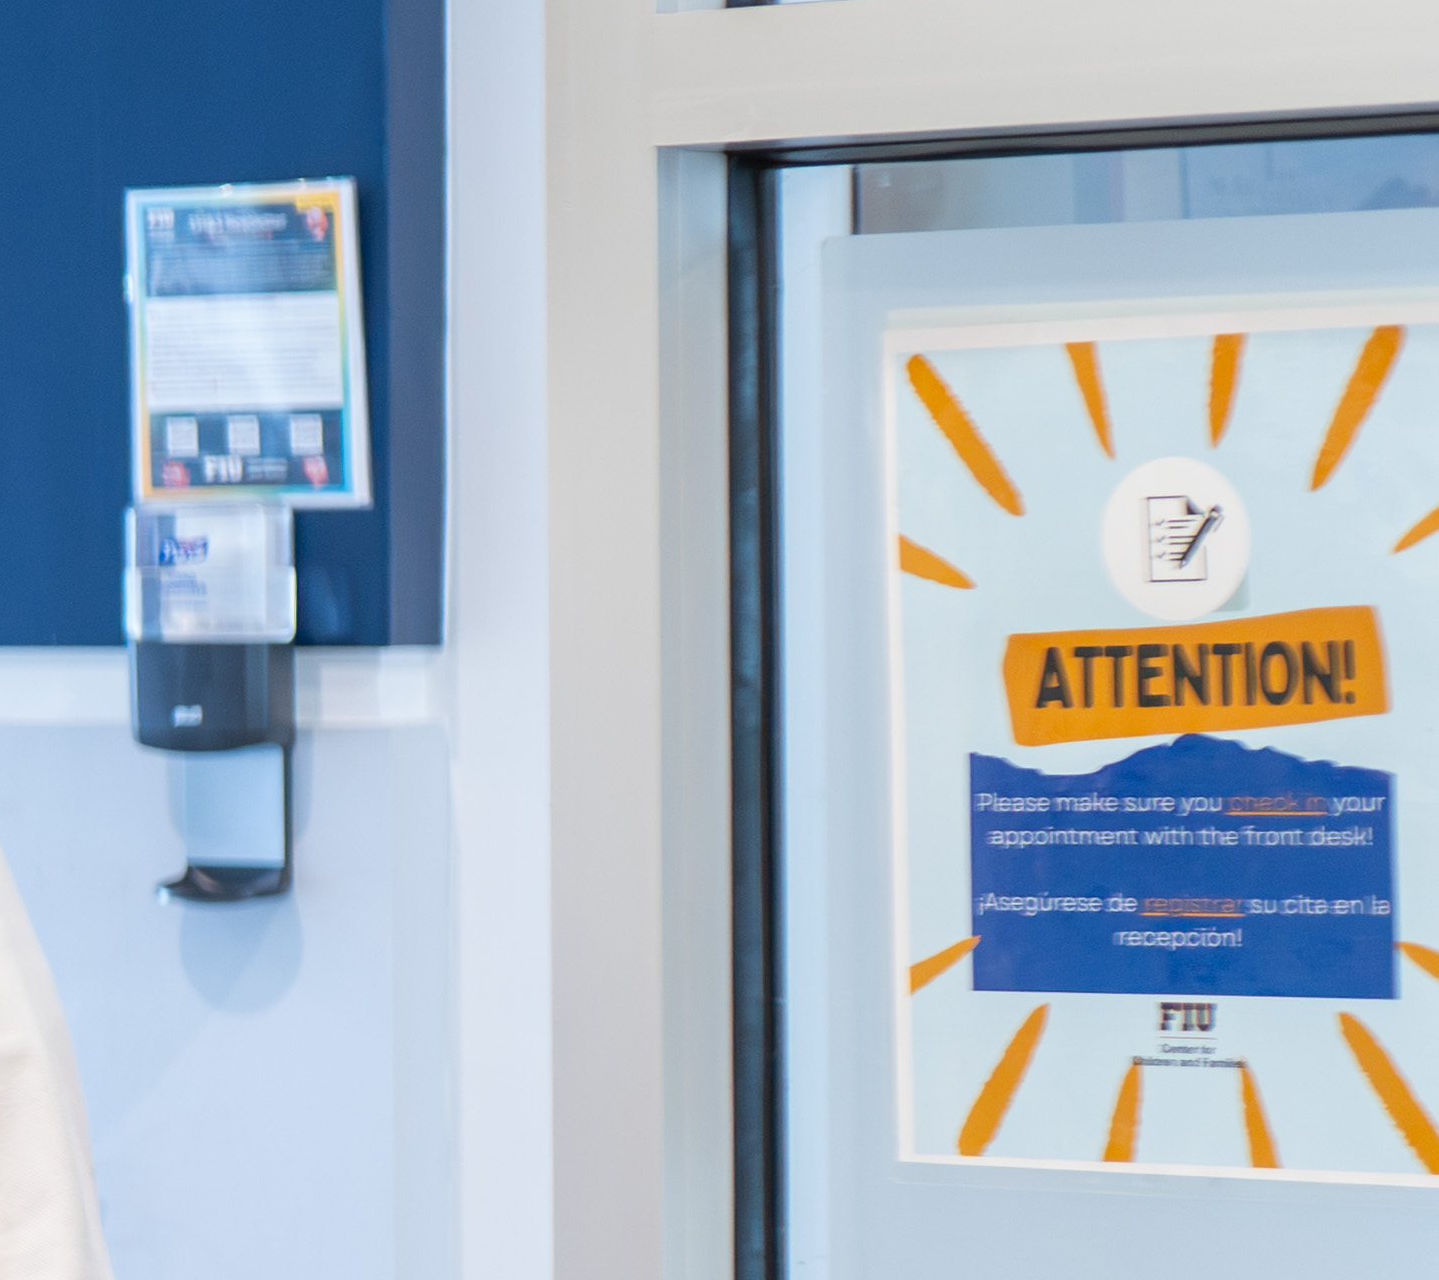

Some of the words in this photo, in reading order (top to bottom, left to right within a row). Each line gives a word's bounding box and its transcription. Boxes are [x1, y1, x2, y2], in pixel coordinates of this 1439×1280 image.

[1034, 639, 1357, 709] ATTENTION!
[974, 792, 1051, 812] Please
[1056, 792, 1119, 812] make
[1124, 796, 1176, 812] sure
[1179, 796, 1223, 817] you
[1229, 790, 1298, 812] check
[1305, 793, 1329, 812] in
[1332, 796, 1386, 817] your
[988, 826, 1139, 849] appointment
[1144, 826, 1195, 846] with
[1201, 825, 1239, 846] the
[1244, 825, 1304, 846] front
[1311, 825, 1374, 847] desk!
[976, 891, 1103, 917] ¡Asegúrese
[1107, 892, 1138, 913] de
[1144, 894, 1243, 916] registrar
[1249, 898, 1278, 914] su
[1282, 894, 1329, 915] cita
[1332, 898, 1364, 915] en
[1371, 895, 1391, 915] la
[1117, 927, 1243, 951] recepción!
[1158, 1001, 1217, 1032] FIU
